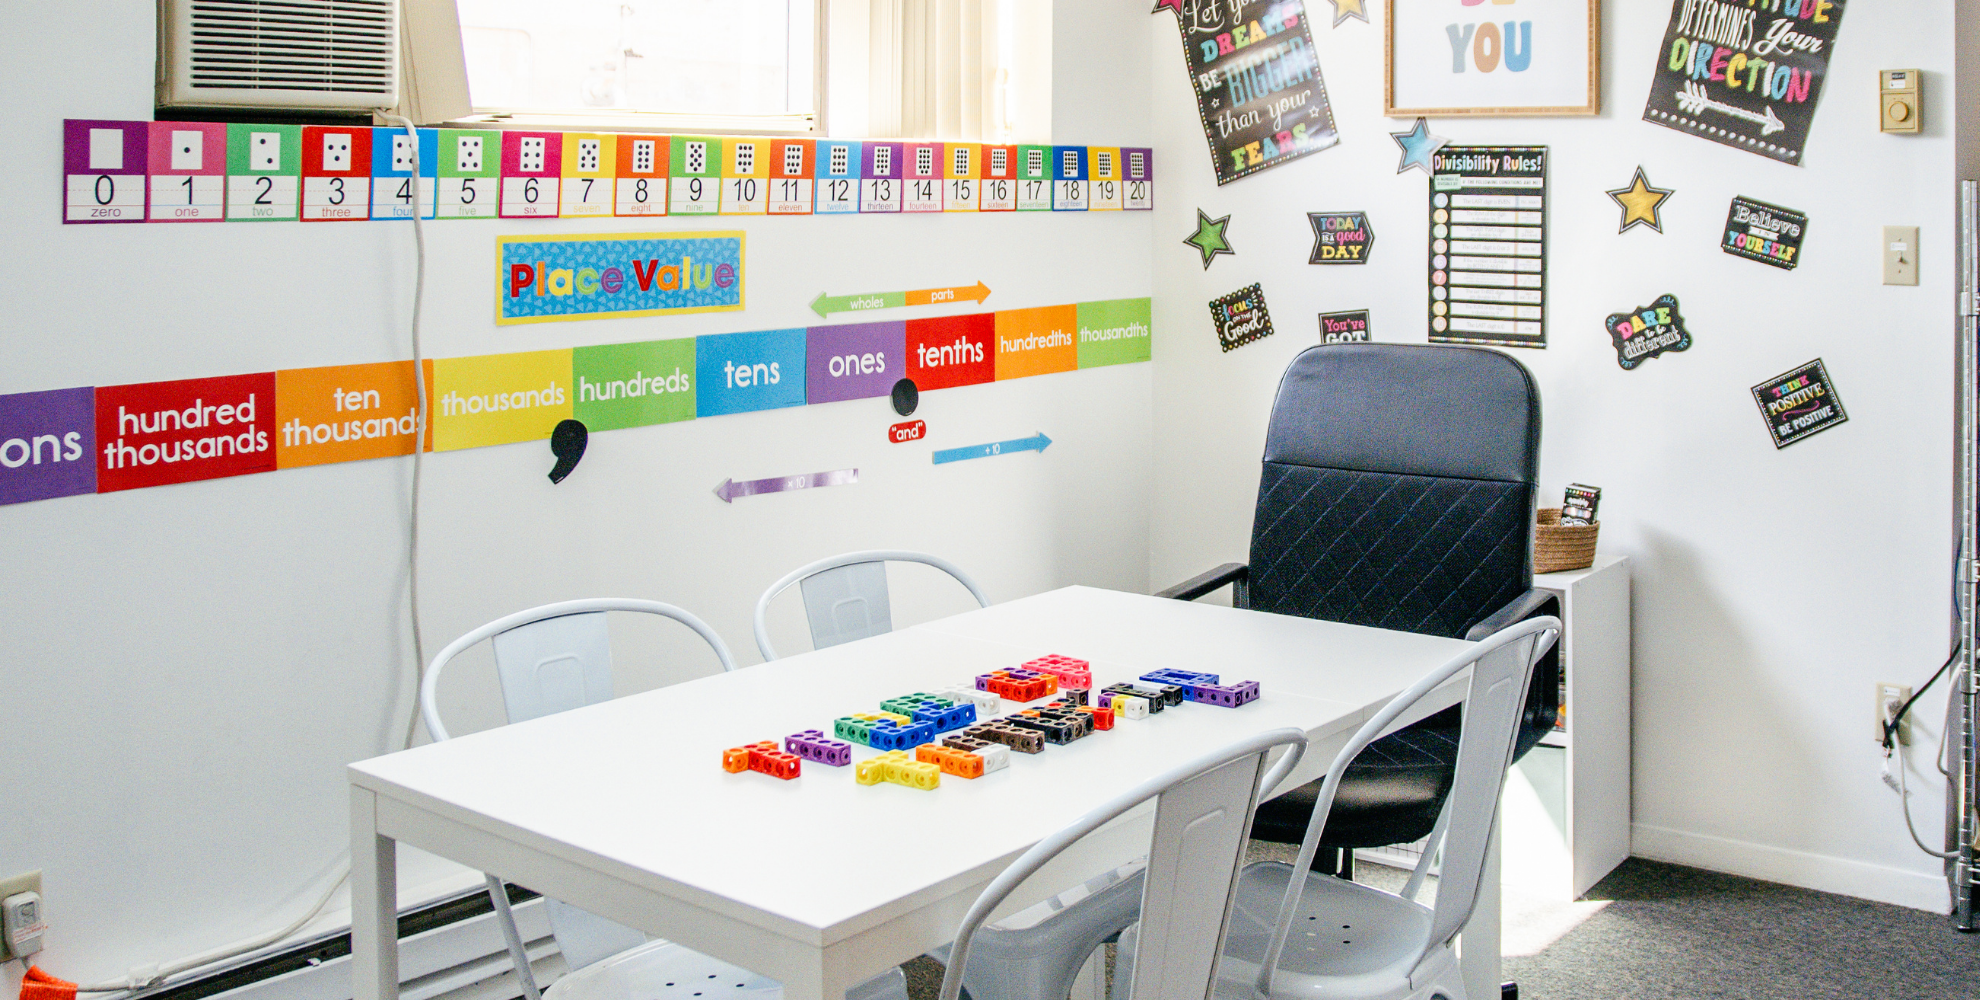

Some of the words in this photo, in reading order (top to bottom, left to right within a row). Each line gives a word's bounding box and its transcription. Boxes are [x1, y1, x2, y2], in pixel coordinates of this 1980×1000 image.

[1201, 4, 1298, 63] DREAMS
[1676, 0, 1757, 50] DETERMINES
[1752, 18, 1824, 56] Your
[1446, 20, 1532, 74] YOU
[1199, 69, 1222, 92] BE
[1224, 36, 1312, 108] BIGGER
[1669, 37, 1812, 103] DIRECTION
[1216, 110, 1262, 138] than
[1268, 89, 1311, 131] your
[1434, 154, 1500, 174] Divisibility
[1503, 155, 1542, 171] Rules!
[94, 175, 114, 205] 0
[181, 176, 193, 204] 1
[254, 177, 272, 204] 2
[328, 178, 344, 205] 3
[396, 178, 412, 204] 4
[461, 178, 476, 204] 5
[524, 178, 539, 204] 6
[580, 178, 594, 202] 7
[635, 178, 648, 202] 8
[690, 178, 702, 202] 9
[734, 178, 756, 202] 10
[782, 178, 798, 202] 11
[828, 180, 848, 202] 12
[871, 180, 891, 200] 13
[914, 180, 932, 200] 14
[952, 180, 970, 200] 15
[990, 180, 1006, 200] 16
[1026, 180, 1042, 200] 17
[1063, 180, 1079, 200] 18
[1098, 180, 1114, 200] 19
[1130, 180, 1145, 200] 20
[91, 206, 122, 218] zero
[174, 206, 199, 218] one
[252, 206, 274, 217] two
[322, 206, 351, 217] three
[392, 206, 413, 217] four
[458, 206, 476, 216] five
[524, 204, 538, 215] six
[573, 204, 601, 214] seven
[631, 202, 651, 214] eight
[686, 202, 704, 212] nine
[778, 202, 802, 212] eleven
[826, 202, 849, 211] twelve
[867, 201, 894, 210] thirteen
[909, 201, 937, 210] fourteen
[987, 200, 1008, 209] sixteen
[1060, 200, 1082, 208] eighteen
[1320, 217, 1361, 230] TODAY
[1734, 205, 1800, 237] Believe
[1337, 227, 1366, 246] good
[1728, 230, 1796, 261] YOURSELF
[1322, 246, 1362, 259] DAY
[511, 261, 624, 298] Place
[632, 256, 735, 292] Value
[850, 296, 884, 310] wholes
[931, 288, 955, 303] parts
[1222, 298, 1253, 321] focus
[1080, 322, 1148, 343] thousandths
[1224, 309, 1264, 341] Good
[1324, 318, 1365, 331] You've
[1617, 307, 1671, 340] DARE
[1644, 329, 1655, 338] to
[1000, 330, 1072, 353] hundredths
[1326, 331, 1366, 343] GOT
[1624, 325, 1681, 359] different
[917, 336, 984, 368] tenths
[724, 360, 780, 388] tens
[828, 352, 886, 378] ones
[580, 367, 690, 402] hundreds
[1772, 375, 1810, 397] THINK
[333, 386, 380, 412] ten
[441, 381, 565, 416] thousands
[1767, 382, 1826, 416] POSITIVE
[118, 393, 255, 436] hundred
[1778, 423, 1793, 436] BE
[1792, 405, 1834, 430] POSITIVE
[0, 432, 82, 468] ons
[104, 425, 268, 470] thousands
[992, 443, 1000, 456] 10
[796, 476, 805, 488] 10
